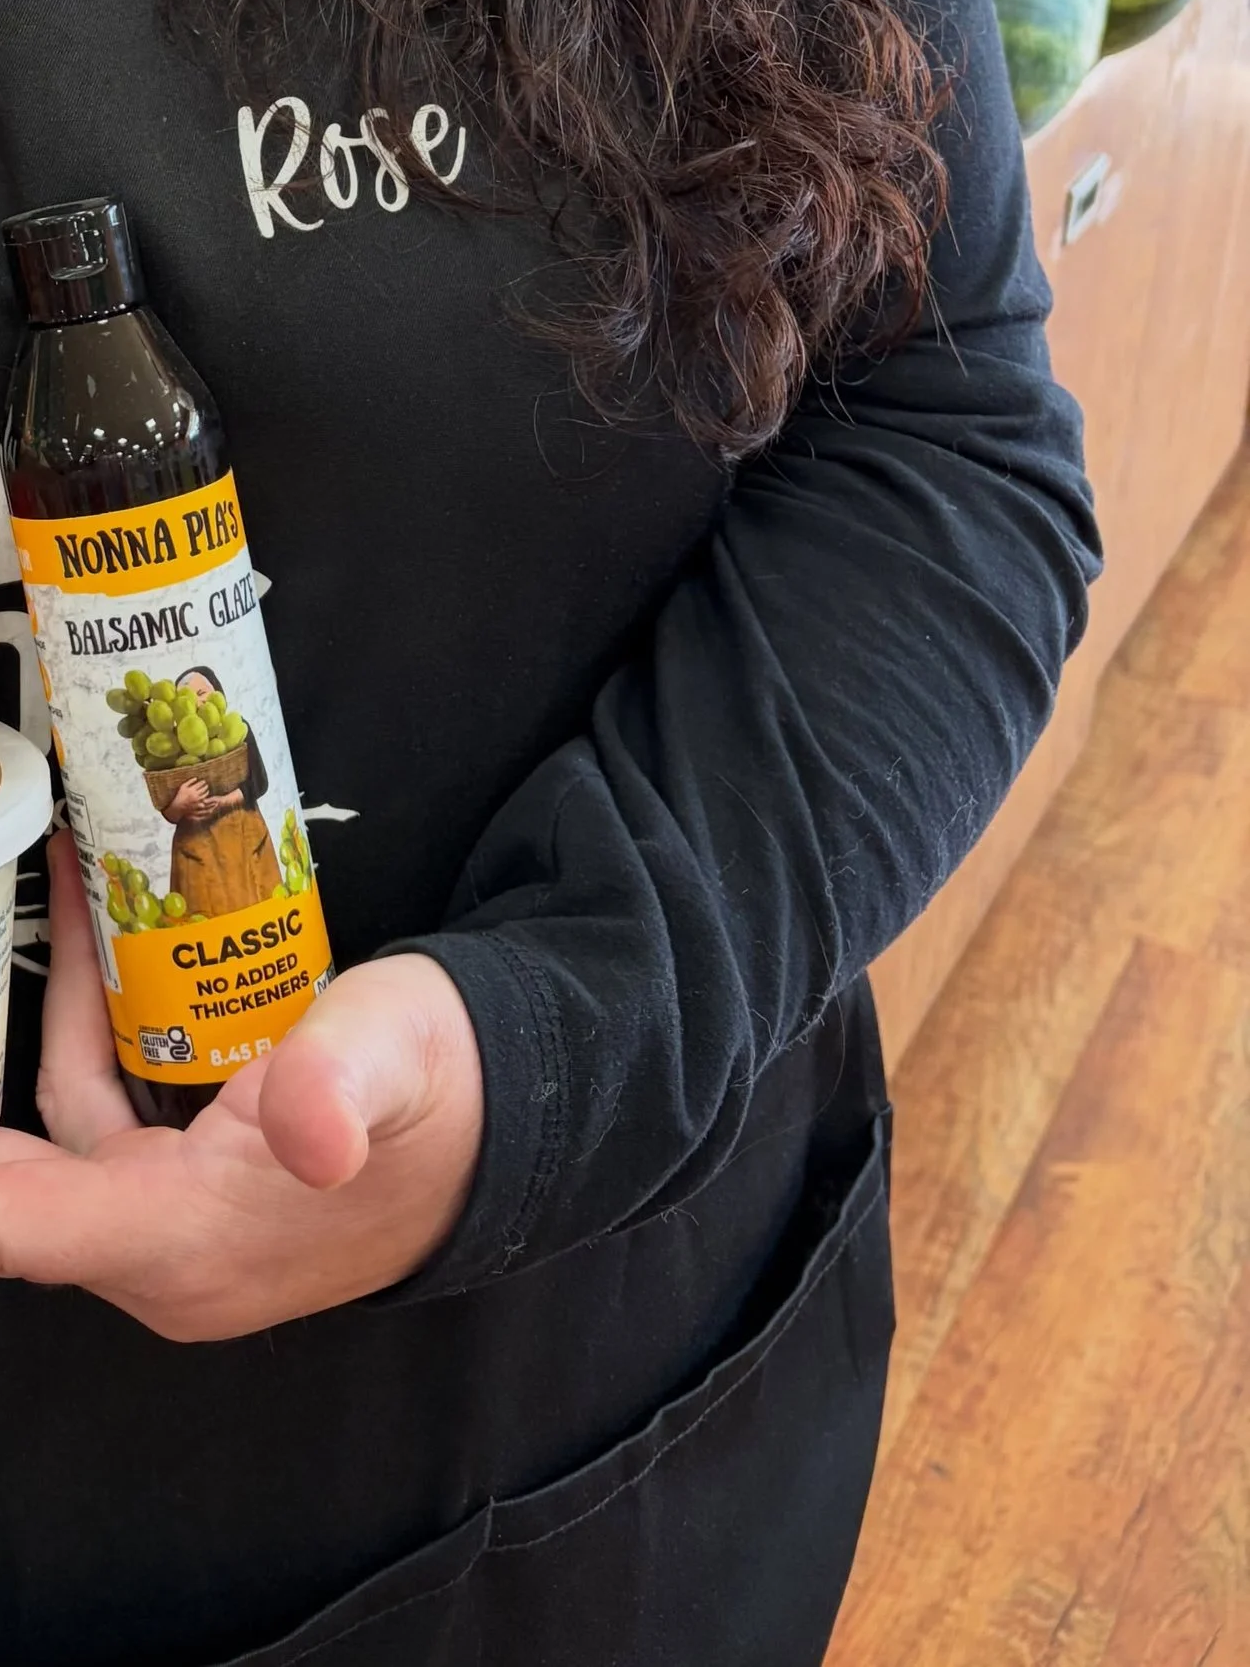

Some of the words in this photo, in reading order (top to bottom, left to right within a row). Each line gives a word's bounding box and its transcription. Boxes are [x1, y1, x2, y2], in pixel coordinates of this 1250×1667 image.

[238, 96, 466, 238] Rose
[183, 500, 238, 556] PIA'S
[65, 602, 199, 656] BALSAMIC
[208, 573, 257, 628] GLAZE
[171, 909, 303, 970] CLASSIC
[189, 970, 310, 1021] THICKENERS
[196, 977, 229, 997] NO
[235, 952, 298, 990] ADDED
[141, 1035, 170, 1048] GLUTEN
[143, 1046, 161, 1059] FREE
[210, 1042, 252, 1067] 8.45
